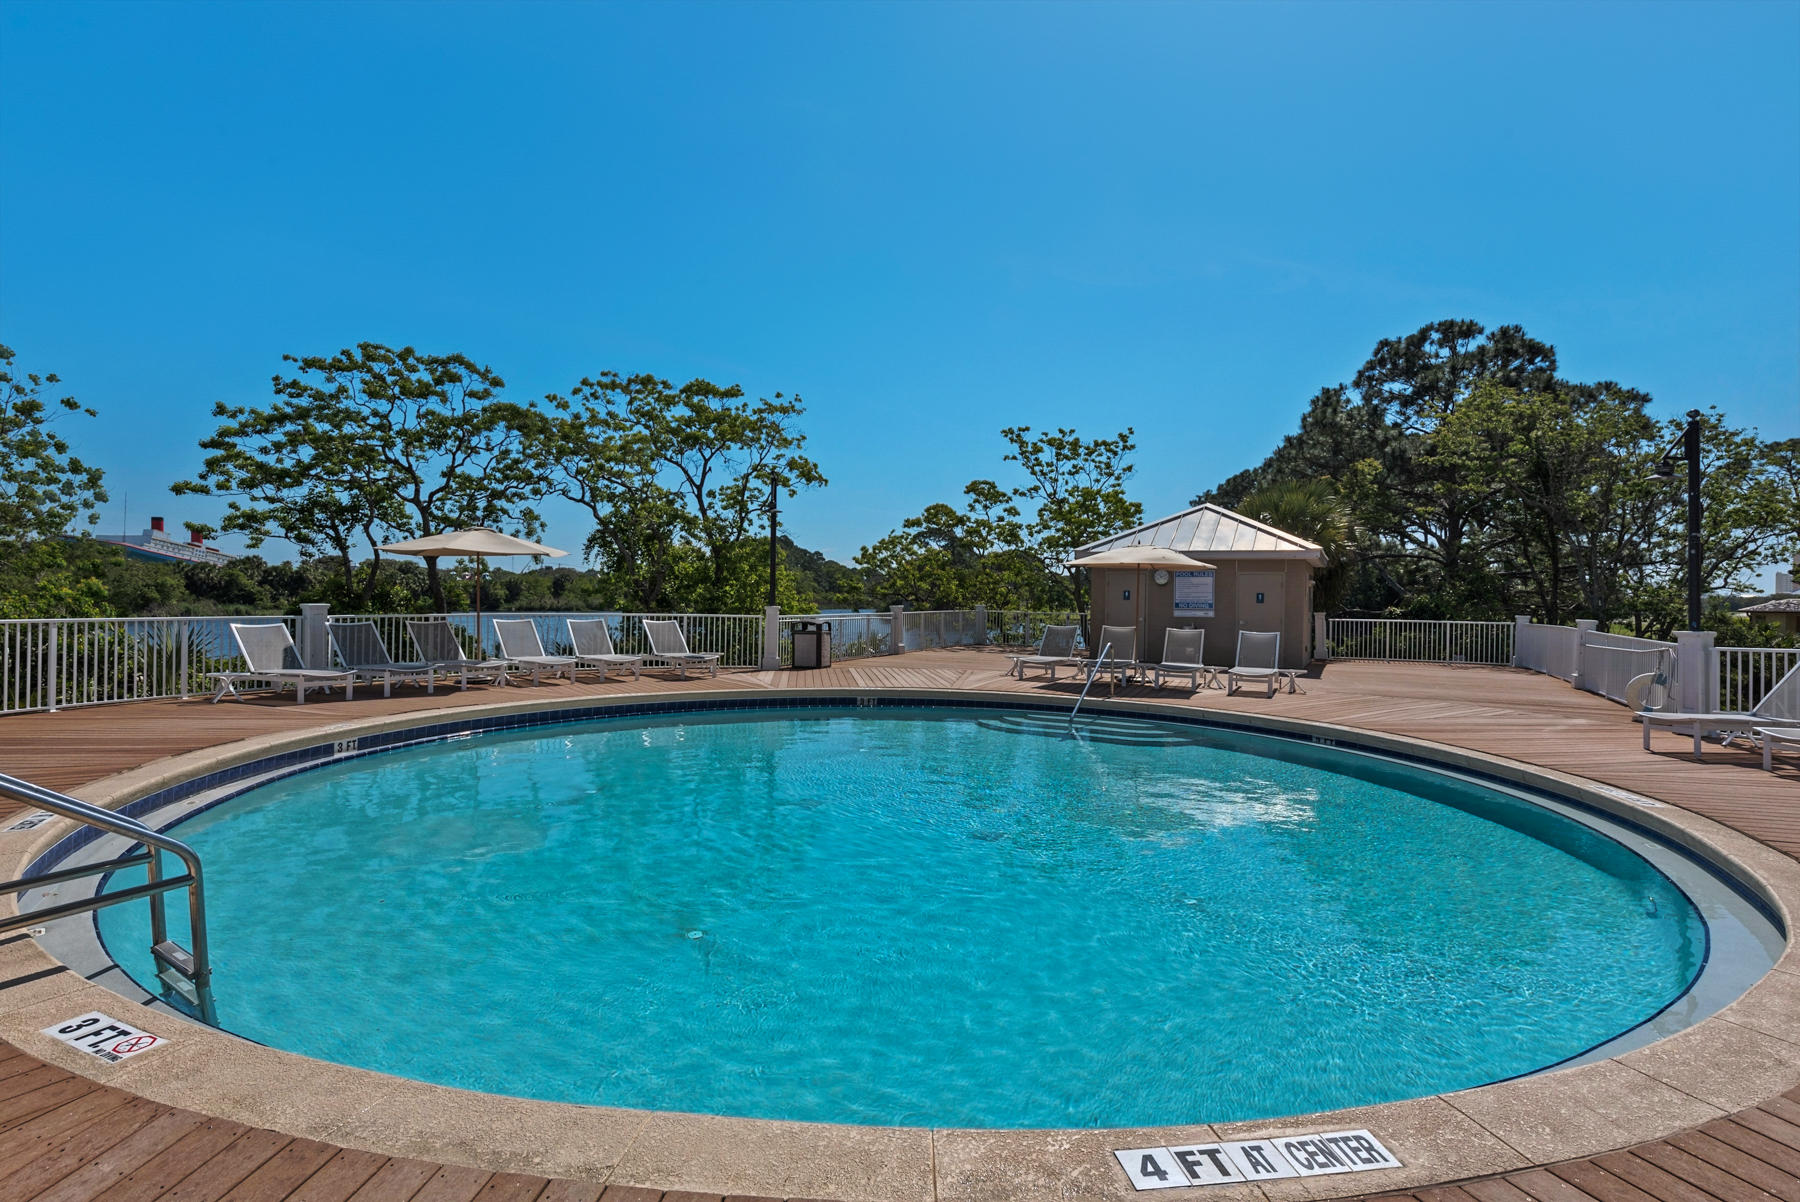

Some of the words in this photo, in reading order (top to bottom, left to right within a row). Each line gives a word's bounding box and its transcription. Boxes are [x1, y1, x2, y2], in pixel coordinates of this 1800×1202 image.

[337, 742, 343, 753] 3
[346, 740, 357, 751] FT
[58, 1018, 100, 1034] 3
[1140, 1154, 1169, 1181] 4
[1174, 1148, 1232, 1179] FT
[1239, 1145, 1278, 1174] AT
[1284, 1135, 1390, 1170] CENTER
